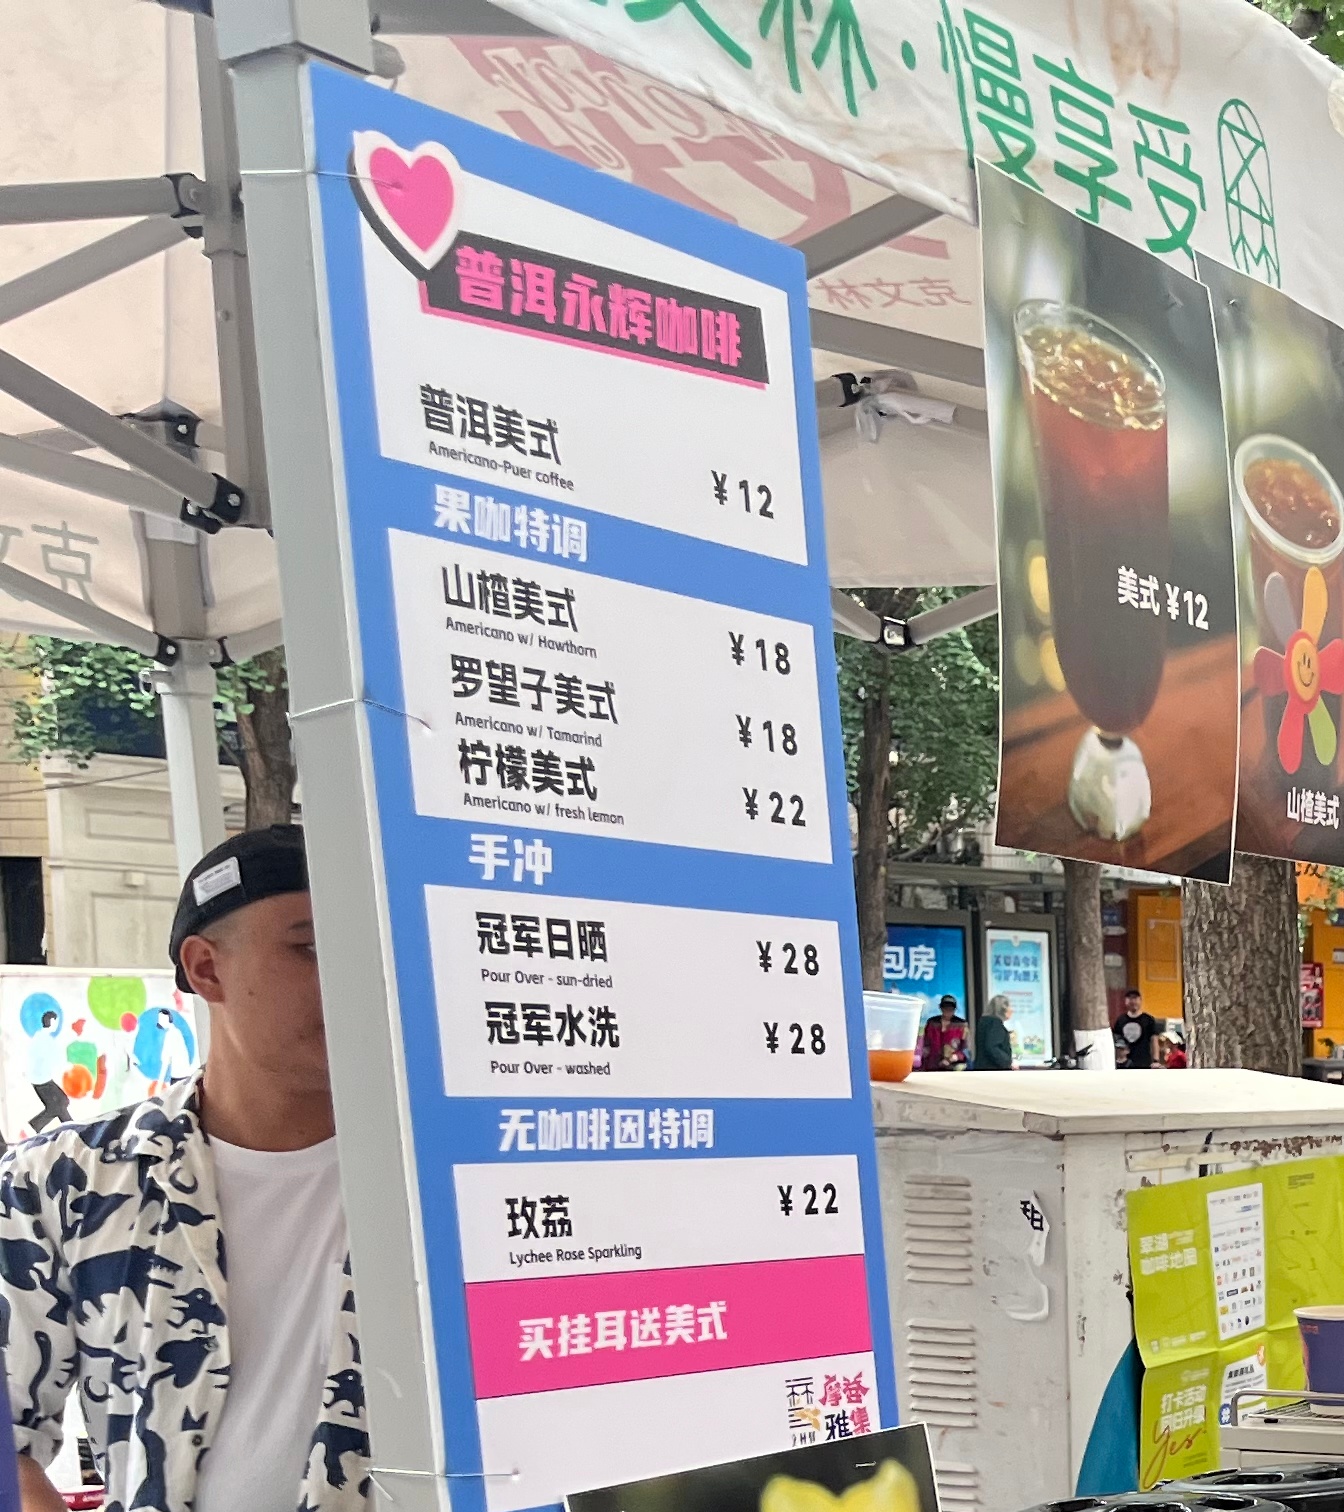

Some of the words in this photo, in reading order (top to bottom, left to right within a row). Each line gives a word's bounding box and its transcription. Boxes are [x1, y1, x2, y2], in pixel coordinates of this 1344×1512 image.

[453, 244, 742, 369] 普洱永辉咖啡
[419, 383, 563, 467] 普洱美式
[427, 440, 531, 483] Americano-Puer
[533, 469, 576, 492] coffee
[711, 470, 775, 522] ¥12
[434, 485, 588, 564] 果咖特调
[443, 564, 578, 634] 山楂美式
[1117, 563, 1160, 617] 美式
[1165, 582, 1209, 632] ¥12
[445, 616, 515, 645] Americano
[517, 629, 535, 647] w/
[537, 633, 598, 660] Hawthorn
[728, 631, 791, 676] ¥18
[450, 653, 619, 727] 罗望子美式
[455, 711, 525, 738] Americano
[527, 724, 544, 739] w/
[546, 726, 603, 748] Tamarind
[735, 715, 799, 757] ¥18
[458, 738, 599, 802] 柠檬美式
[463, 791, 534, 816] Americano
[535, 801, 552, 818] w/
[554, 803, 585, 822] fresh
[587, 806, 624, 825] lemon
[742, 786, 807, 828] ¥22
[1286, 786, 1340, 831] 山楂美式
[467, 833, 554, 886] 手冲
[475, 910, 609, 964] 冠军日晒
[756, 940, 820, 976] ¥28
[480, 968, 513, 985] Pour
[514, 970, 545, 986] Over
[556, 972, 613, 990] sun-dried
[883, 942, 937, 981] 包房
[484, 1001, 620, 1050] 冠军水洗
[764, 1020, 827, 1056] ¥28
[490, 1058, 521, 1076] Pour
[523, 1060, 554, 1075] Over
[565, 1059, 611, 1076] washed
[498, 1108, 715, 1153] 无咖啡因特调
[505, 1195, 573, 1240] 玫荔
[776, 1182, 840, 1217] ¥22
[509, 1248, 554, 1267] Lychee
[556, 1247, 586, 1263] Rose
[587, 1243, 642, 1264] Sparkling
[518, 1301, 728, 1362] 买挂耳送美式
